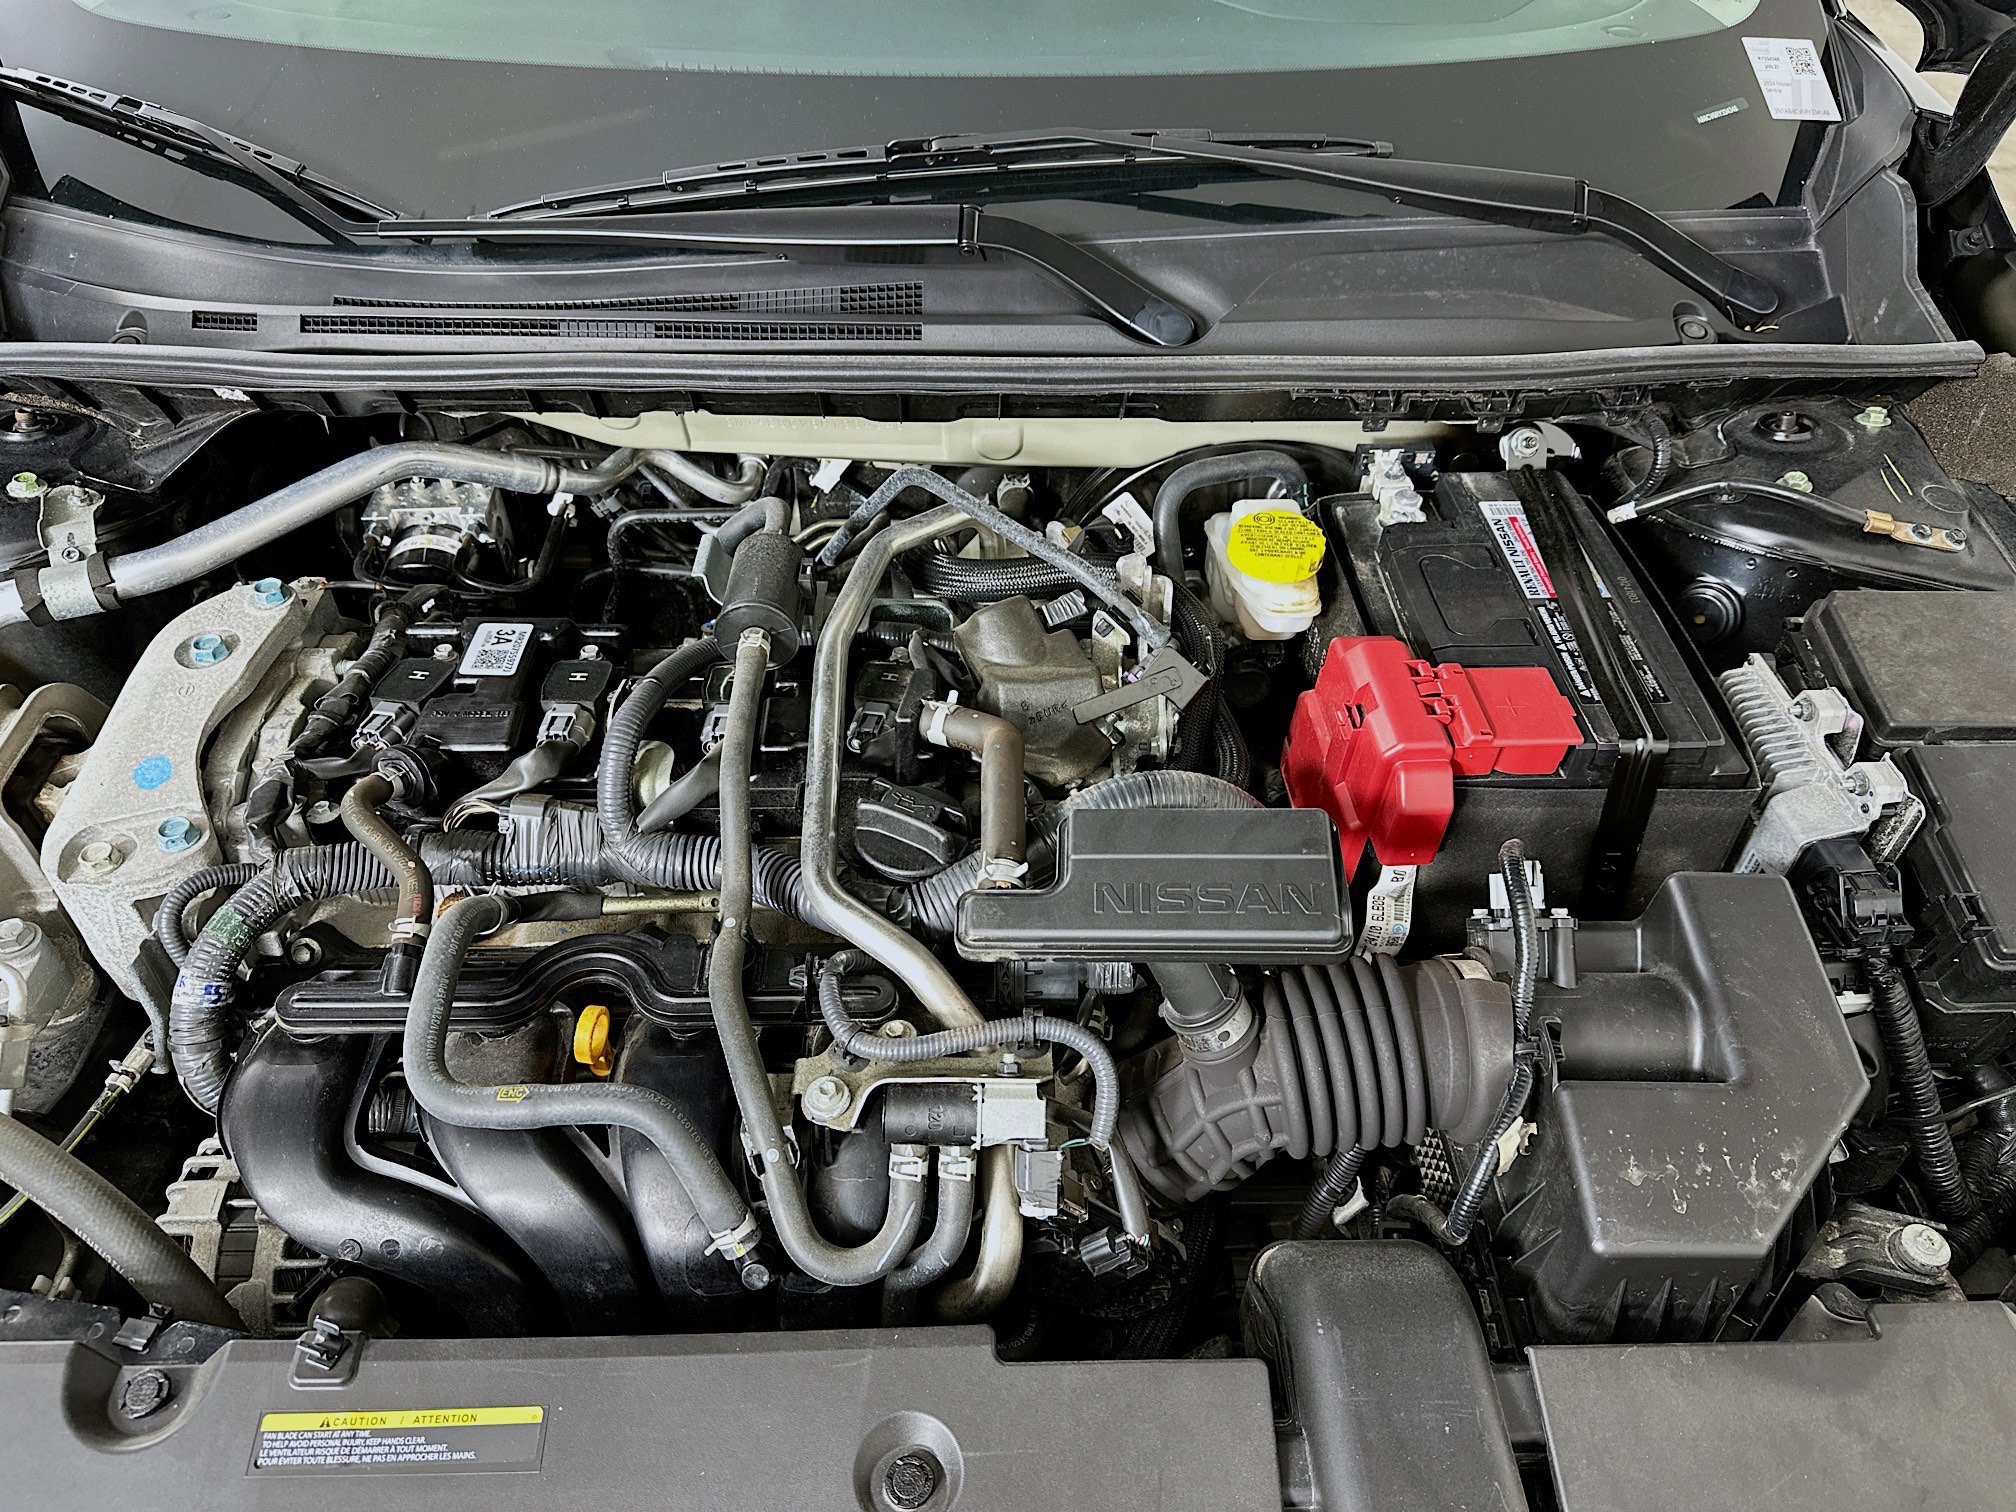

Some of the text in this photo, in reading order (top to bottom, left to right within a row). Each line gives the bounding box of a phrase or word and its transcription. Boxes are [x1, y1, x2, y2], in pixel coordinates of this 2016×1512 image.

[1492, 518, 1520, 556] NISSAN
[1512, 560, 1540, 596] RENAULT
[490, 630, 516, 646] 3A
[1094, 882, 1322, 914] NISSAN
[333, 1416, 388, 1426] CAUTION
[412, 1414, 478, 1424] ATTENTION
[289, 1440, 309, 1448] AVOID
[396, 1453, 439, 1461] APPROCHER
[452, 1451, 477, 1459] MAINS.
